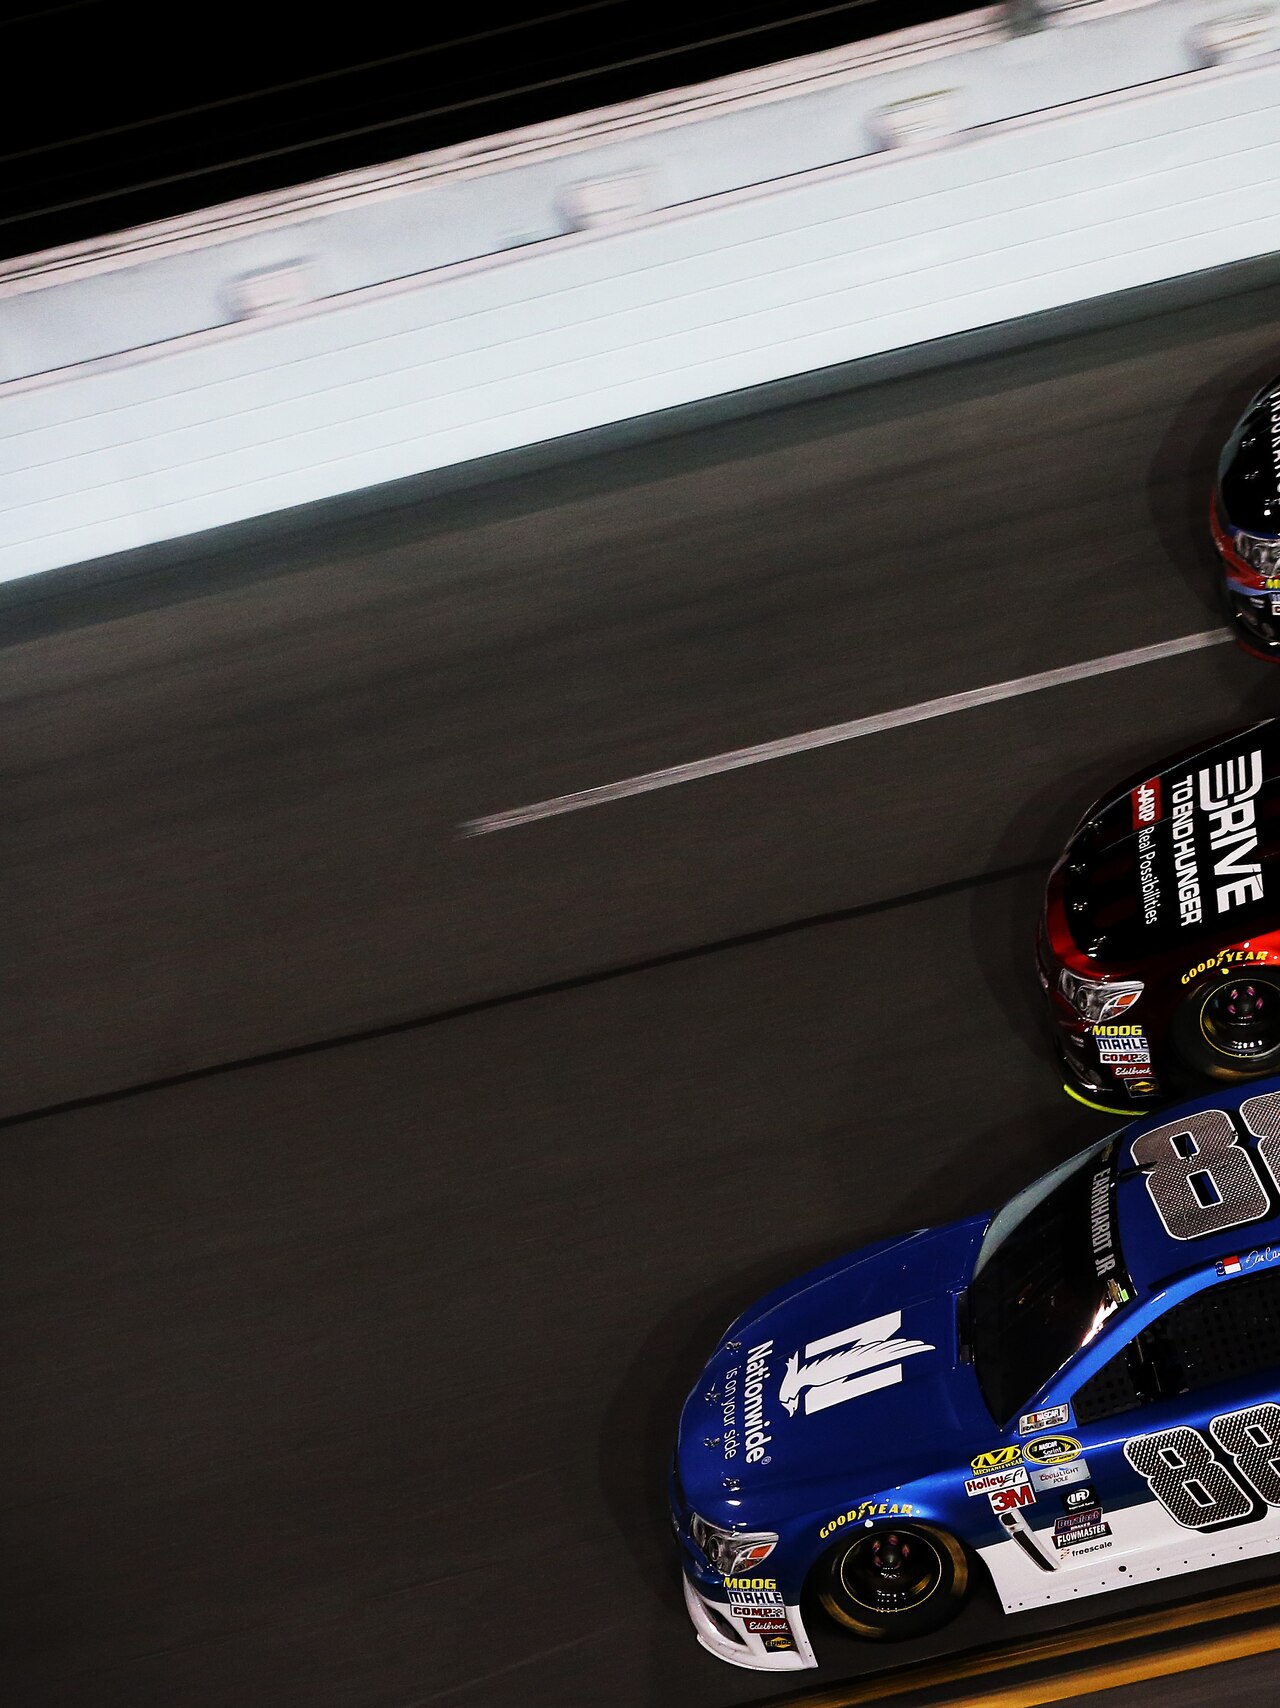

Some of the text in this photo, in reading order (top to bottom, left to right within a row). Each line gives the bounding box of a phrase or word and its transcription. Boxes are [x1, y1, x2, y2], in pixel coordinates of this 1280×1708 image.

[1199, 750, 1264, 914] DRIVE
[1137, 784, 1161, 925] AARP Real Possibilities
[1172, 774, 1202, 927] TO END HUNGER
[1181, 949, 1269, 986] GOODYEAR
[1092, 1025, 1142, 1036] MOOG
[1098, 1038, 1149, 1050] MAHLE
[1102, 1053, 1138, 1062] COMP
[1115, 1067, 1152, 1076] Edelbrock
[1090, 1167, 1116, 1277] EARNHARDT JR
[721, 1366, 741, 1460] is on your side
[1037, 1410, 1059, 1420] NASCAR
[1023, 1417, 1063, 1431] RACE CAR
[1042, 1447, 1062, 1456] Sprint
[973, 1457, 1024, 1476] MECHANIX WEAR
[967, 1469, 1024, 1492] Holley EFI
[1053, 1476, 1068, 1484] POLE
[992, 1485, 1034, 1512] 3M
[819, 1501, 913, 1539] GOODYEAR
[1057, 1524, 1106, 1547] FLOWMASTER
[1072, 1541, 1112, 1556] freescale
[724, 1577, 776, 1589] MOOG
[729, 1592, 783, 1604] MAHLE
[733, 1607, 773, 1616] COMP
[749, 1621, 787, 1630] Edelbrock
